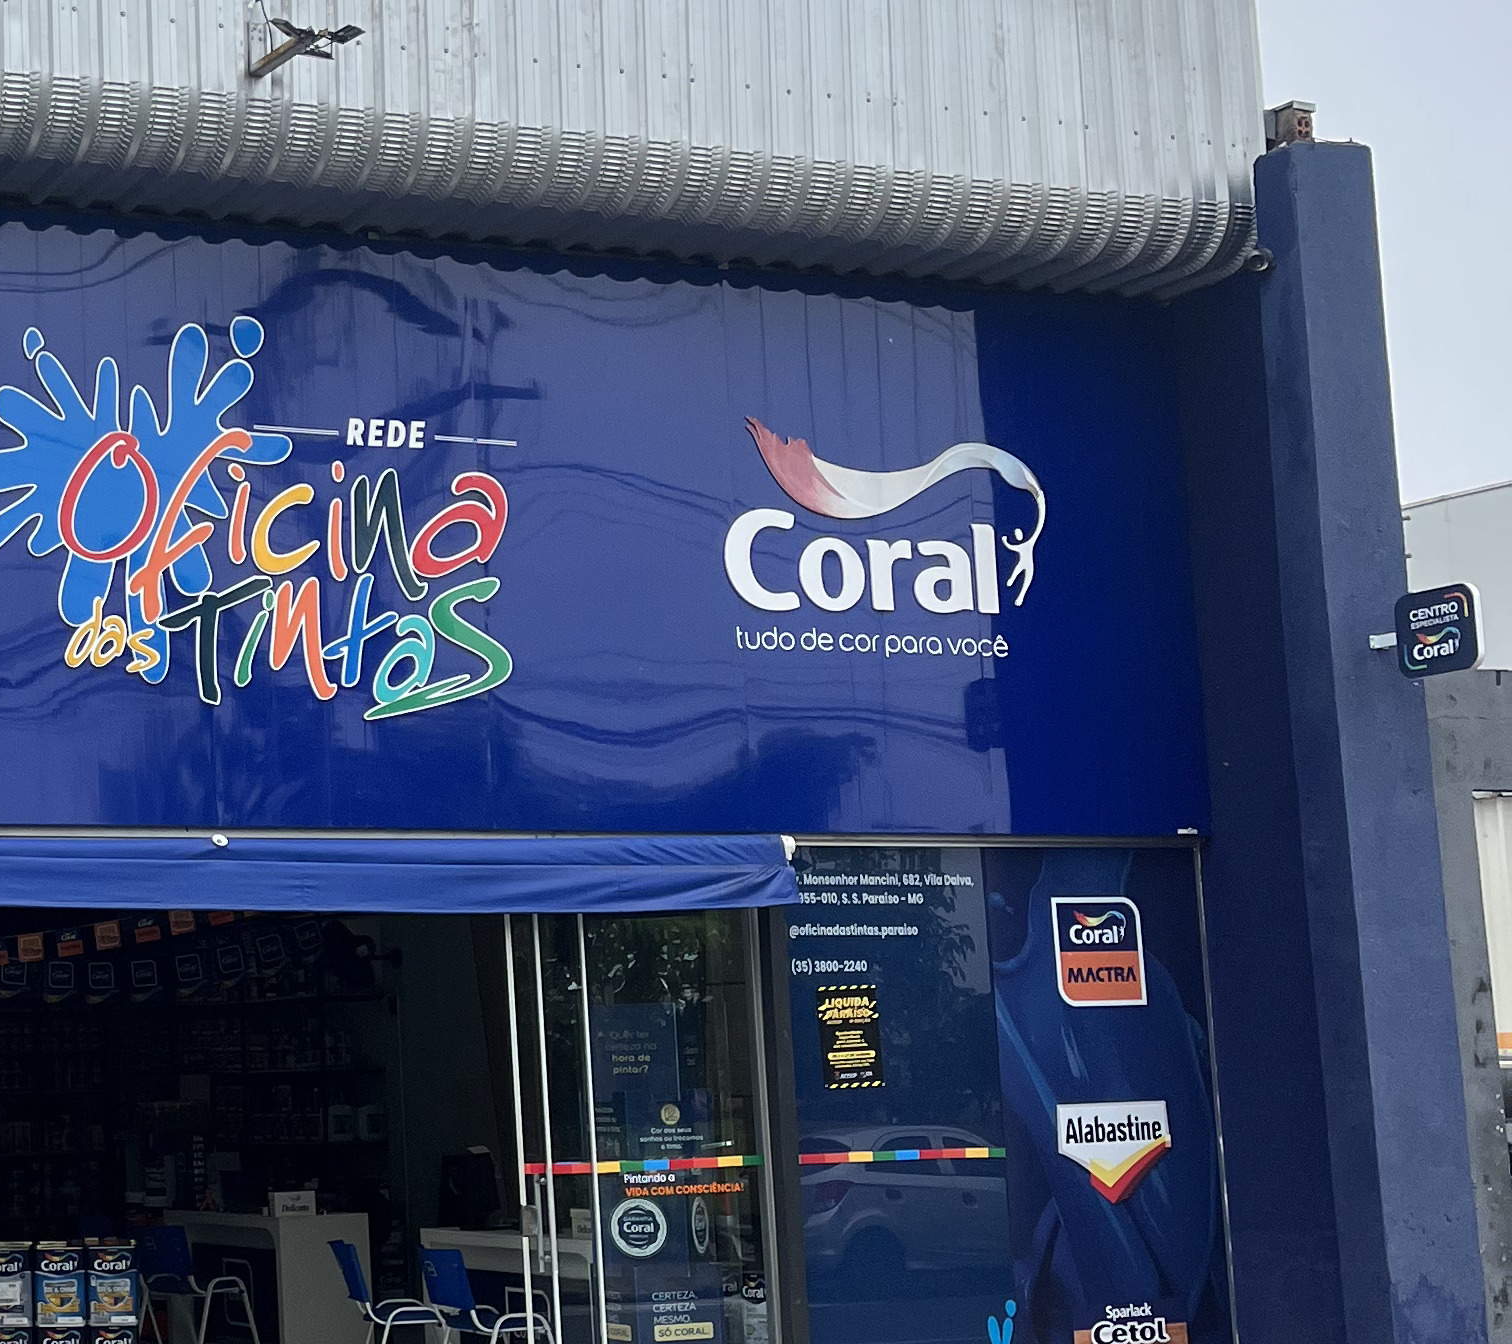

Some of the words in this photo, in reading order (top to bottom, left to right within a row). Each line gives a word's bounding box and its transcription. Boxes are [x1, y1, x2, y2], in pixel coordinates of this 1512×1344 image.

[346, 418, 427, 449] REDE
[58, 429, 509, 624] Oficina
[723, 507, 1000, 614] Coral
[1408, 601, 1459, 622] CENTRO
[1410, 613, 1459, 630] ESPECIALISTA
[64, 596, 161, 674] das
[735, 624, 796, 652] tudo
[800, 627, 834, 652] de
[839, 632, 878, 654] cor
[885, 634, 943, 658] para
[946, 635, 1009, 658] você
[1412, 638, 1455, 661] Coral
[803, 873, 858, 886] Monsenhor
[859, 873, 901, 887] Mancini,
[902, 874, 922, 887] 682,
[923, 874, 943, 885] Vila
[944, 874, 975, 888] Dalva,
[841, 893, 851, 904] S.
[852, 893, 862, 904] S.
[907, 892, 924, 904] MG
[789, 922, 919, 939] @oficinadastintas.paraiso
[1069, 924, 1119, 945] Coral
[791, 958, 813, 975] (35)
[814, 959, 868, 973] 3800-2240
[1068, 966, 1137, 984] MACTRA
[612, 1054, 635, 1062] hora
[637, 1053, 651, 1062] de
[613, 1064, 649, 1075] pintar?
[1065, 1113, 1163, 1144] Alabastine
[624, 1173, 667, 1184] Pintando
[667, 1174, 676, 1183] a
[625, 1186, 650, 1197] VIDA
[651, 1185, 674, 1196] COM
[676, 1181, 744, 1194] CONSCIÊNCIA!
[623, 1222, 655, 1233] Coral
[41, 1260, 74, 1272] Coral
[93, 1259, 127, 1271] Coral
[742, 1285, 765, 1298] Coral
[652, 1302, 697, 1313] CERTEZA
[1105, 1302, 1153, 1322] Sparlack
[658, 1327, 672, 1338] SÓ
